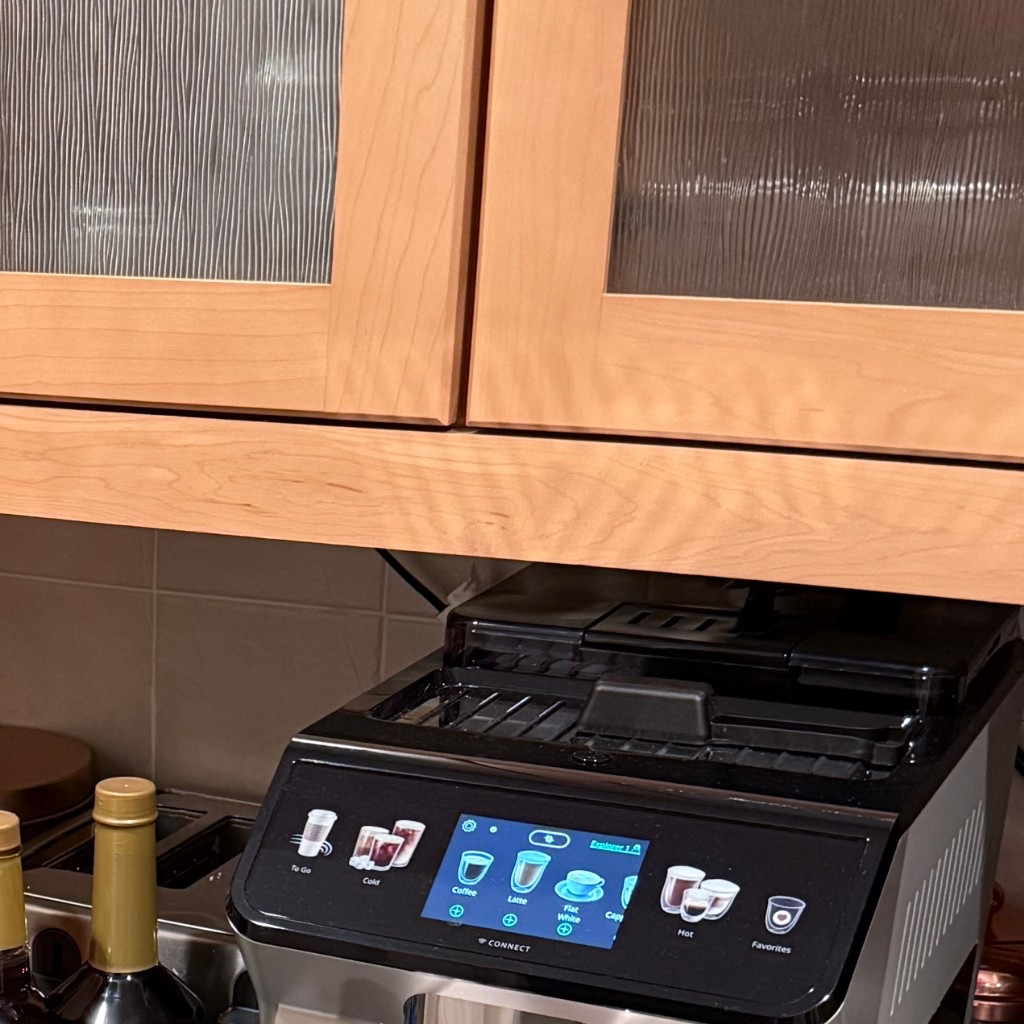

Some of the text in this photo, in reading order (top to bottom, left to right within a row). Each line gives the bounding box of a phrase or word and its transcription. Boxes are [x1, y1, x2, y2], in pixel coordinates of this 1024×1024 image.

[291, 864, 312, 874] To Go
[362, 877, 381, 886] Cold
[451, 886, 478, 897] Coffee
[507, 895, 528, 905] Latte
[563, 904, 580, 914] Flat
[557, 913, 581, 924] White
[677, 928, 694, 939] Hot
[488, 939, 532, 953] CONNECT
[751, 940, 792, 955] Favorites
